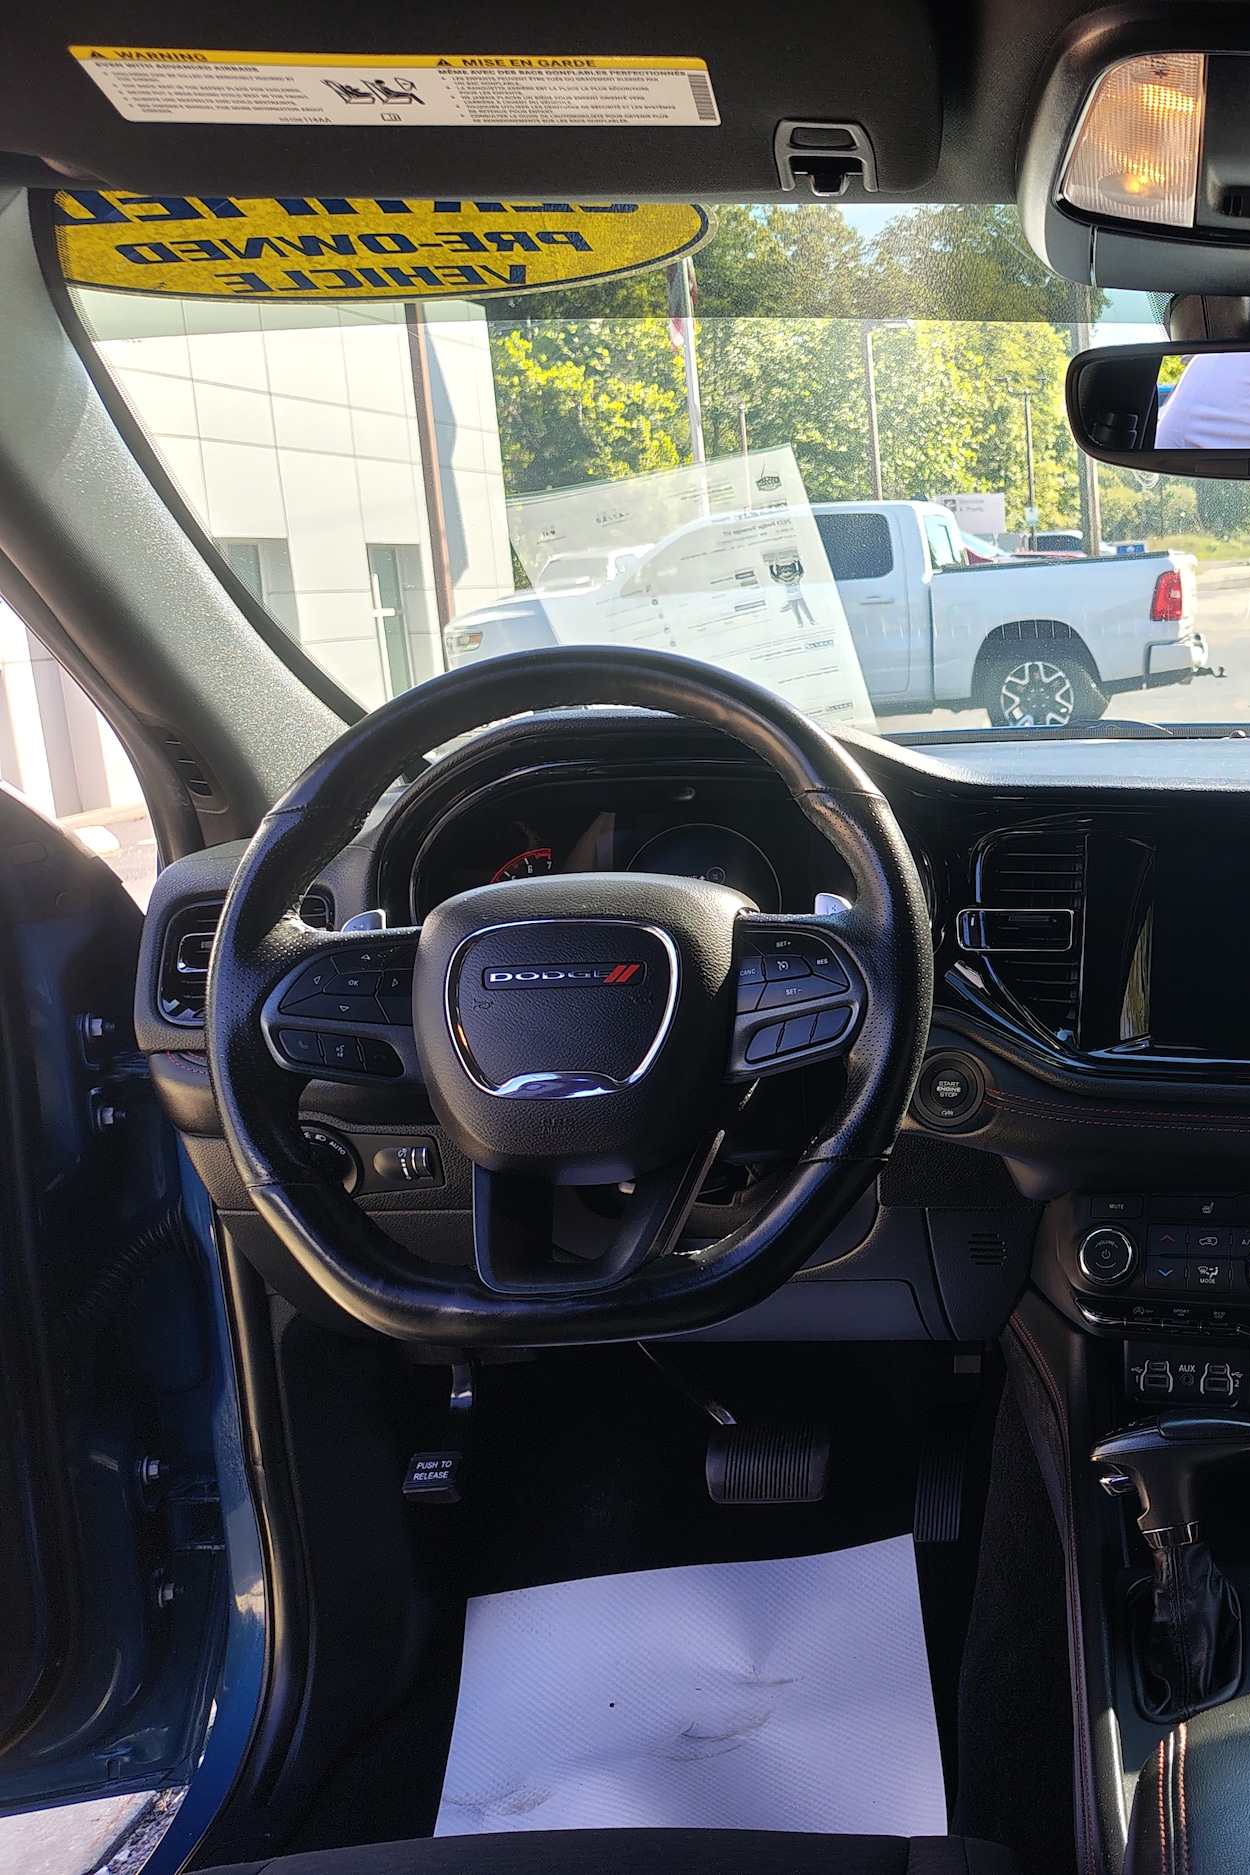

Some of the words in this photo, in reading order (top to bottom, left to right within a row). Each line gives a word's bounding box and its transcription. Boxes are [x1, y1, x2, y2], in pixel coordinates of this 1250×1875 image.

[114, 50, 208, 62] WARNING
[156, 63, 213, 71] ADVANCED
[462, 59, 506, 67] MISE
[510, 59, 534, 67] EN
[538, 59, 597, 67] GARDE
[527, 865, 533, 874] 6
[546, 861, 552, 870] 7
[489, 969, 614, 983] DODGE
[739, 968, 756, 977] CANC
[348, 979, 360, 987] OK
[328, 1140, 346, 1155] AUTO
[1097, 1239, 1116, 1247] VOLUME
[1178, 1364, 1196, 1373] AUX
[1234, 1380, 1240, 1388] 2
[416, 1461, 439, 1470] PUSH
[441, 1460, 453, 1469] TO
[413, 1471, 450, 1481] RELEASE
